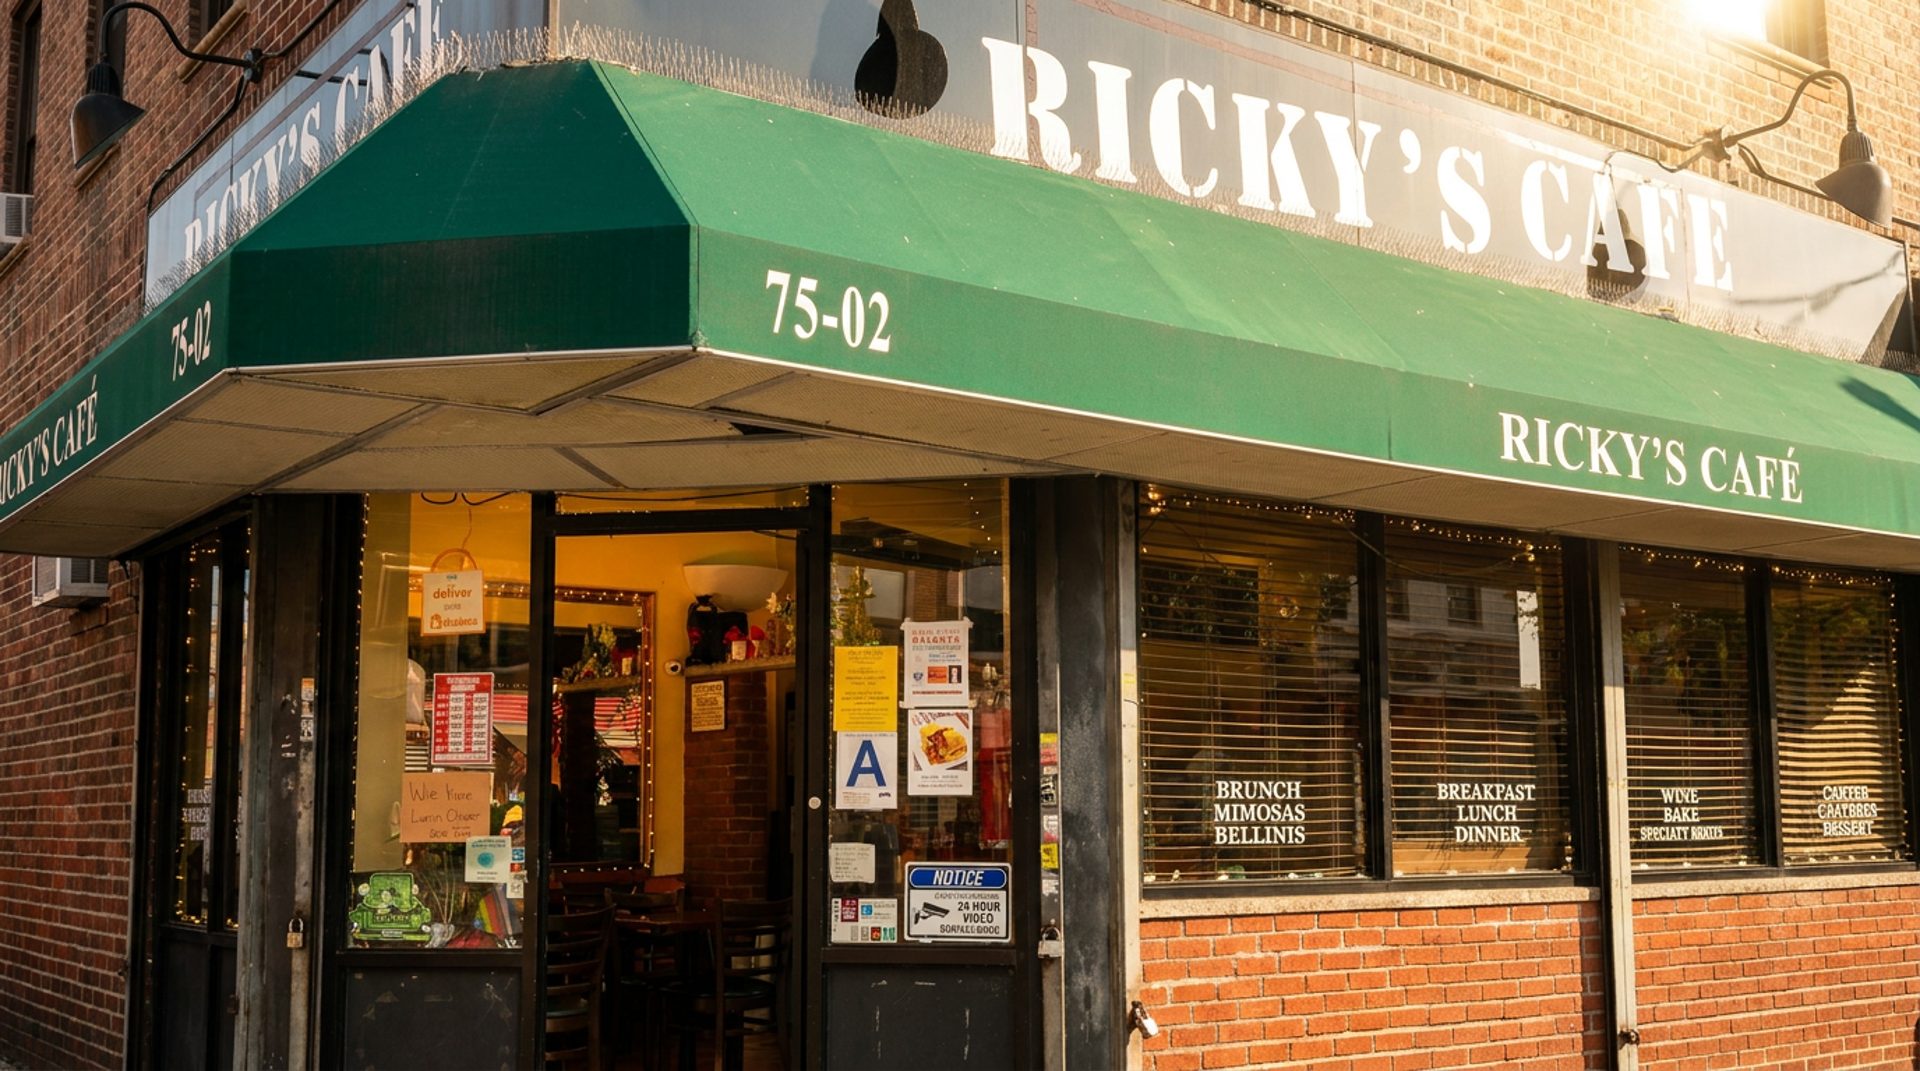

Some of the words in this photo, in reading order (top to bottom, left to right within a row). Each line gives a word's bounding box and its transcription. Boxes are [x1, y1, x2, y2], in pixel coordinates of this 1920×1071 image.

[981, 37, 1492, 255] RICKY'S
[1521, 159, 1734, 292] CAFE
[765, 269, 892, 354] 75-02
[171, 300, 212, 382] 75-02
[0, 427, 50, 505] ICKY'S
[53, 373, 98, 467] CAFÉ
[1498, 411, 1687, 487] RICKY'S
[1700, 446, 1803, 504] CAFÉ
[846, 739, 887, 787] A
[1216, 780, 1302, 800] BRUNCH
[1213, 803, 1306, 823] MIMOSAS
[1456, 805, 1518, 822] LUNCH
[1663, 806, 1700, 823] BAKE
[1214, 826, 1306, 845] BELLINIS
[1454, 825, 1524, 843] DINNER
[933, 869, 985, 887] NOTICE
[957, 901, 970, 912] 24
[973, 901, 1001, 913] HOUR
[963, 913, 994, 924] VIDEO
